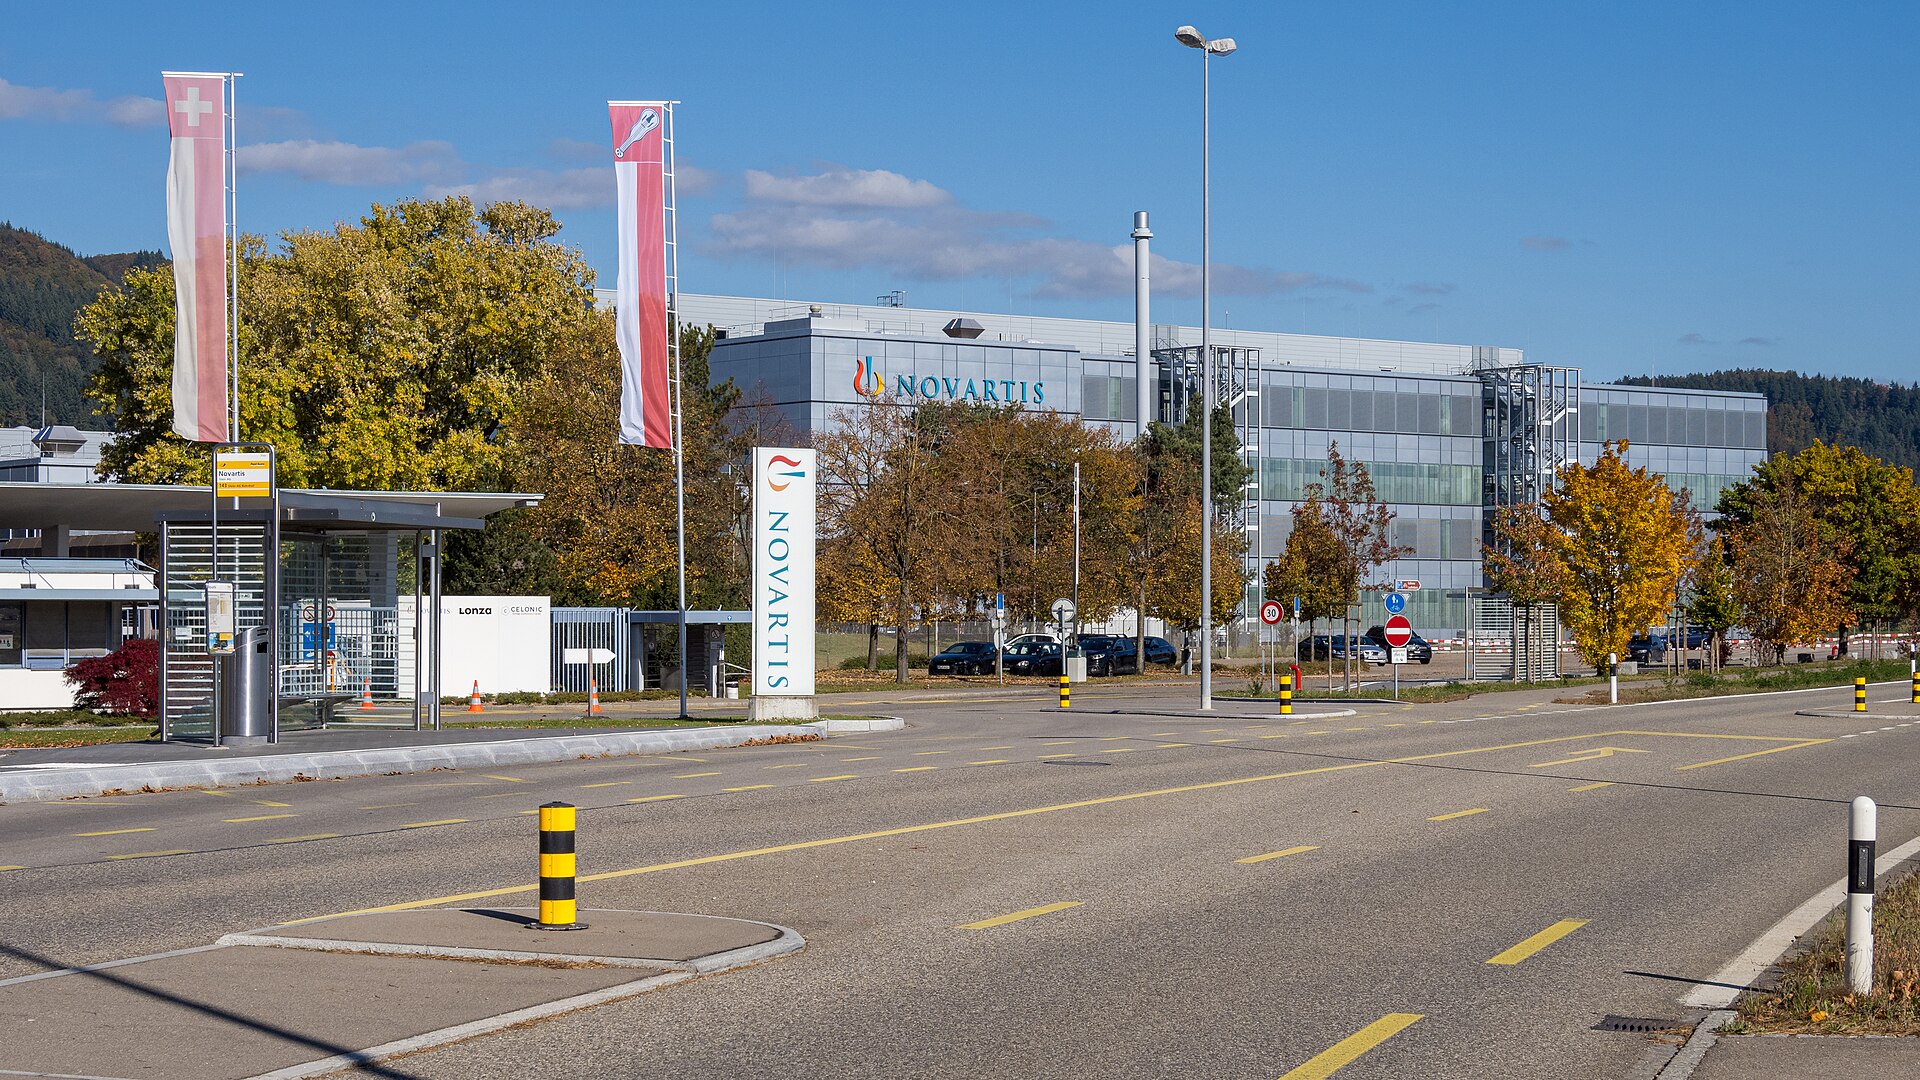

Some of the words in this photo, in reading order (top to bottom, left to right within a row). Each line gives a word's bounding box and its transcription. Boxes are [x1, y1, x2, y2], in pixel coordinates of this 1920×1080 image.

[897, 374, 1045, 403] NOVARTIS
[768, 510, 789, 688] NOVARTIS
[459, 607, 492, 615] Lonza
[1266, 608, 1277, 619] 30
